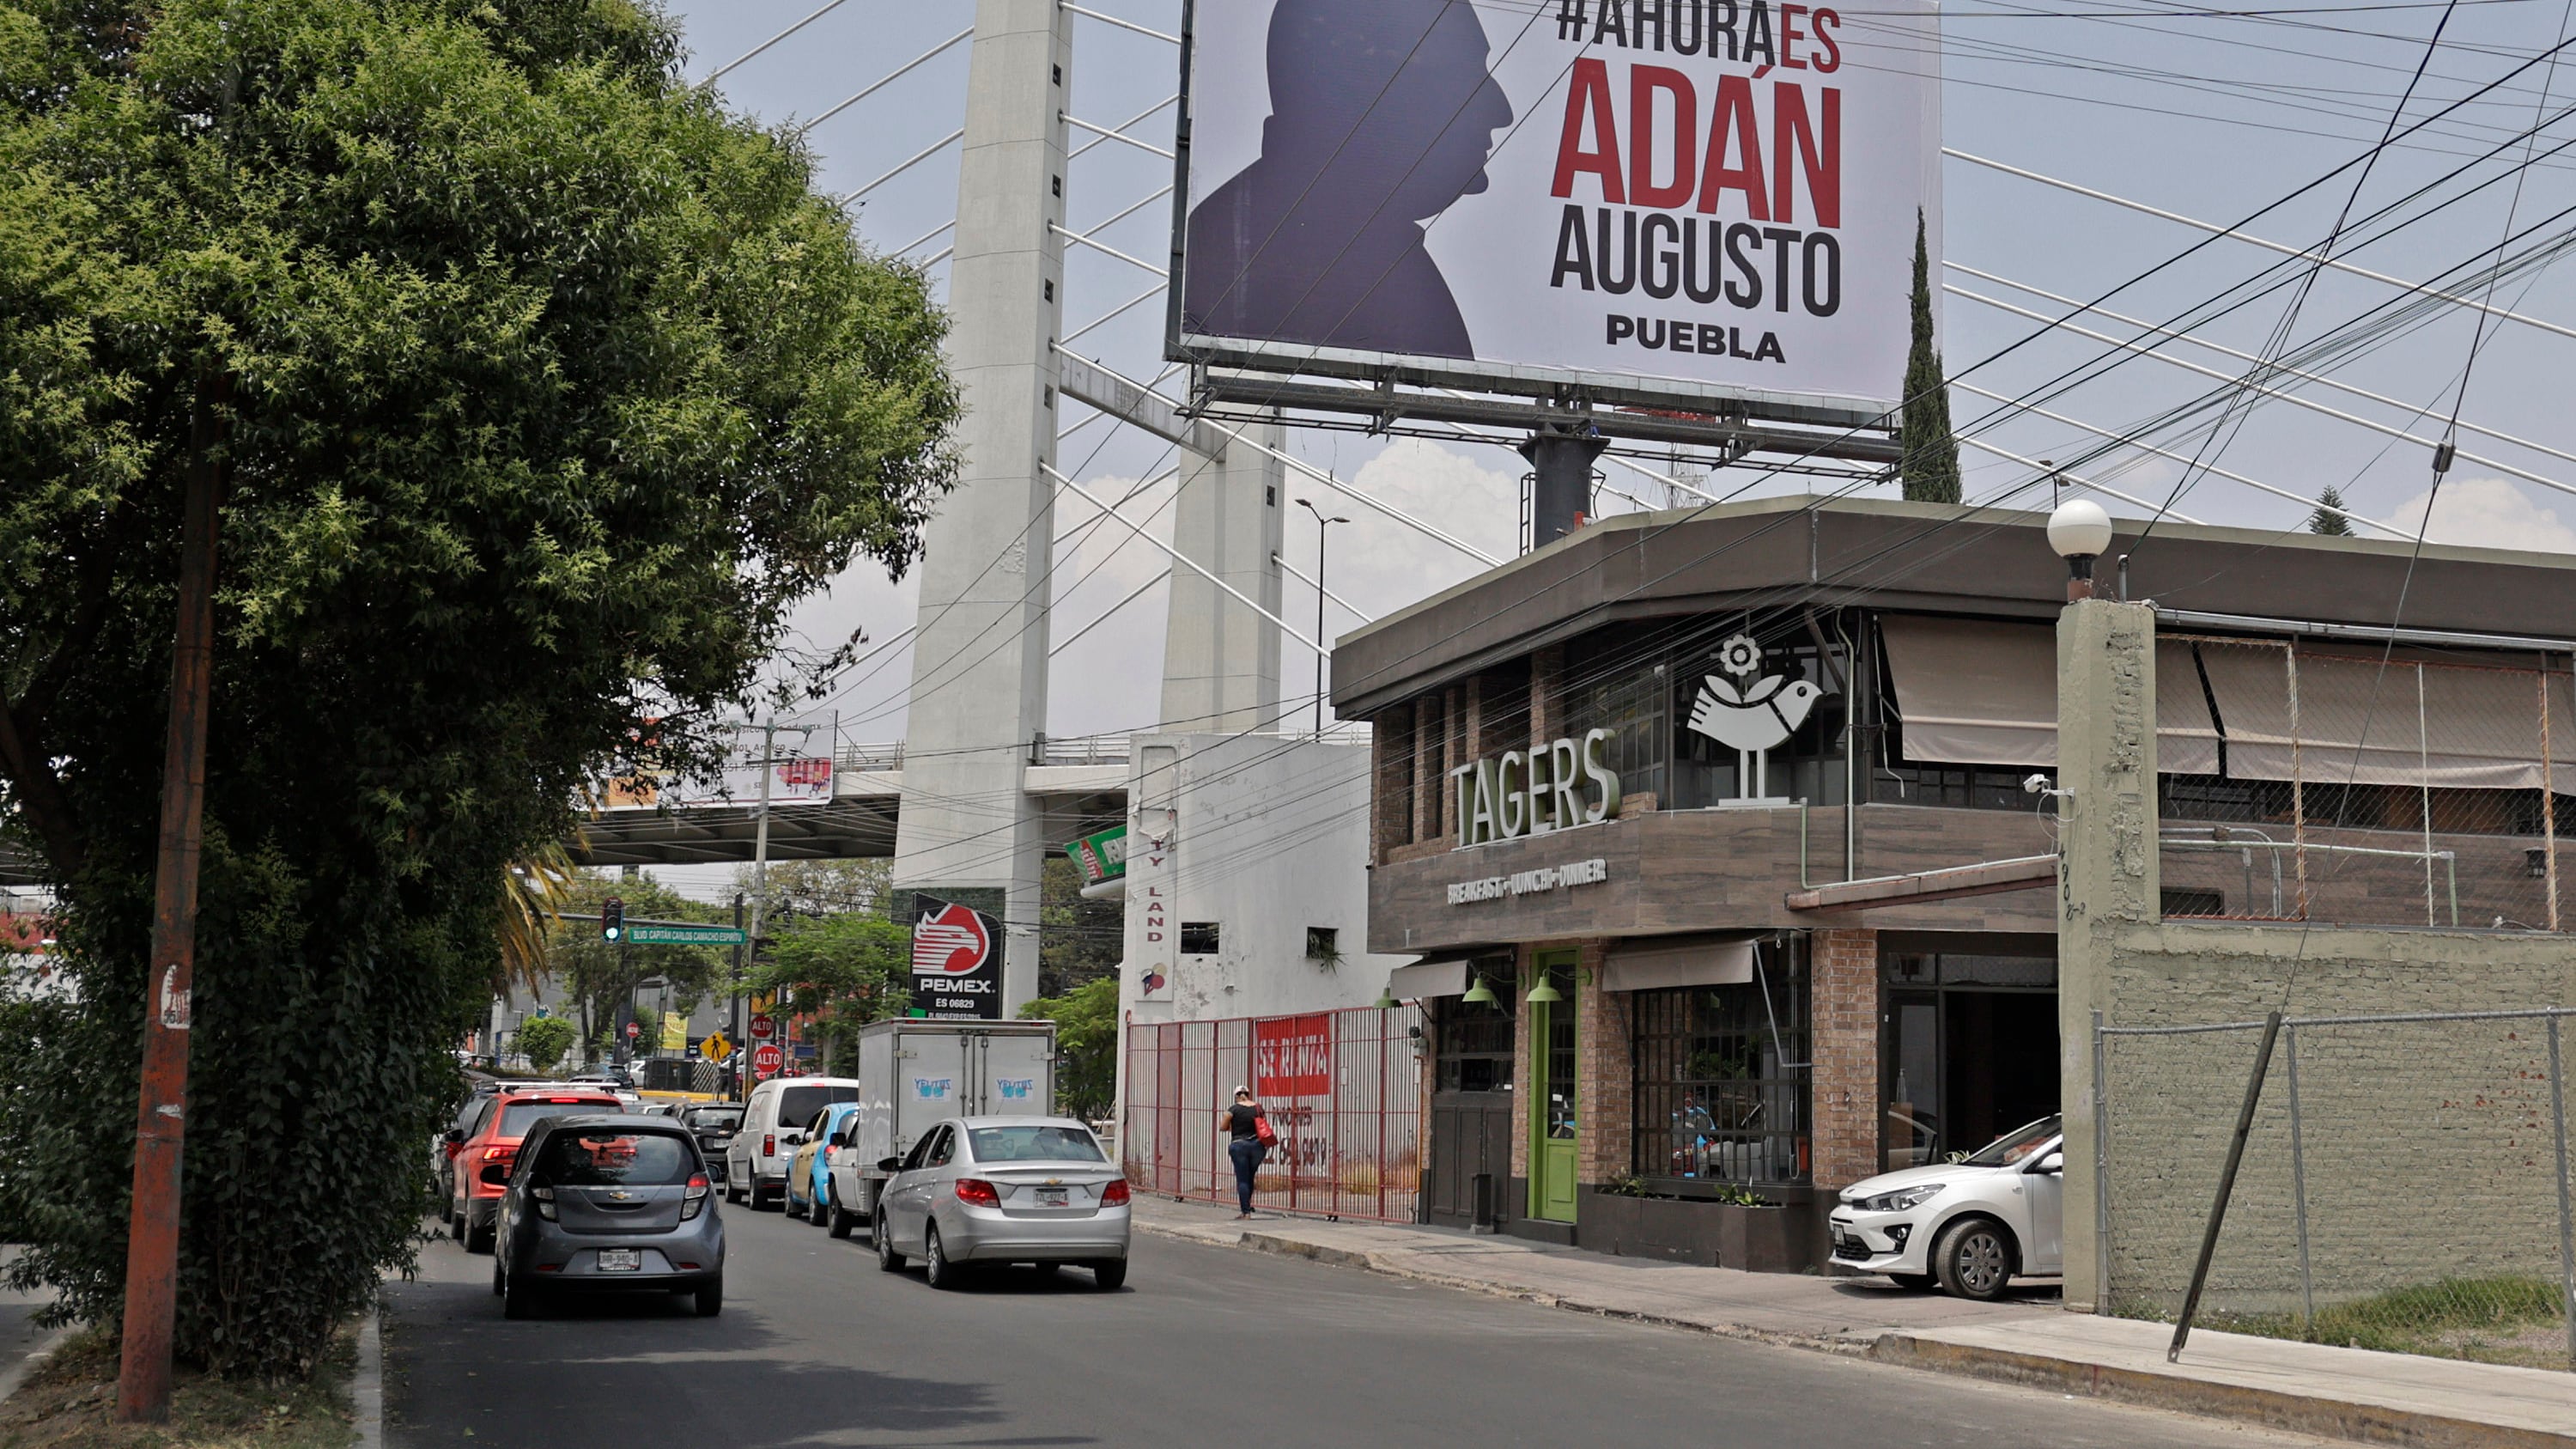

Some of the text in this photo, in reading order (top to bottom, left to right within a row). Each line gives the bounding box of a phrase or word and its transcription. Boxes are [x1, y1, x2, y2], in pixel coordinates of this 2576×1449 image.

[1551, 57, 1841, 230] ADÁN
[1550, 204, 1841, 318] AUGUSTO
[1607, 314, 1787, 364] PUEBLA
[1451, 728, 1620, 847] TAGERS
[1559, 858, 1607, 887] DINNER
[1147, 886, 1164, 942] LAND
[671, 931, 693, 941] CARLOS
[693, 931, 719, 941] CAMACHO
[920, 978, 992, 994] PEMEX
[935, 997, 975, 1008] ES 06829
[751, 1020, 772, 1032] ALTO
[755, 1054, 781, 1066] ALTO
